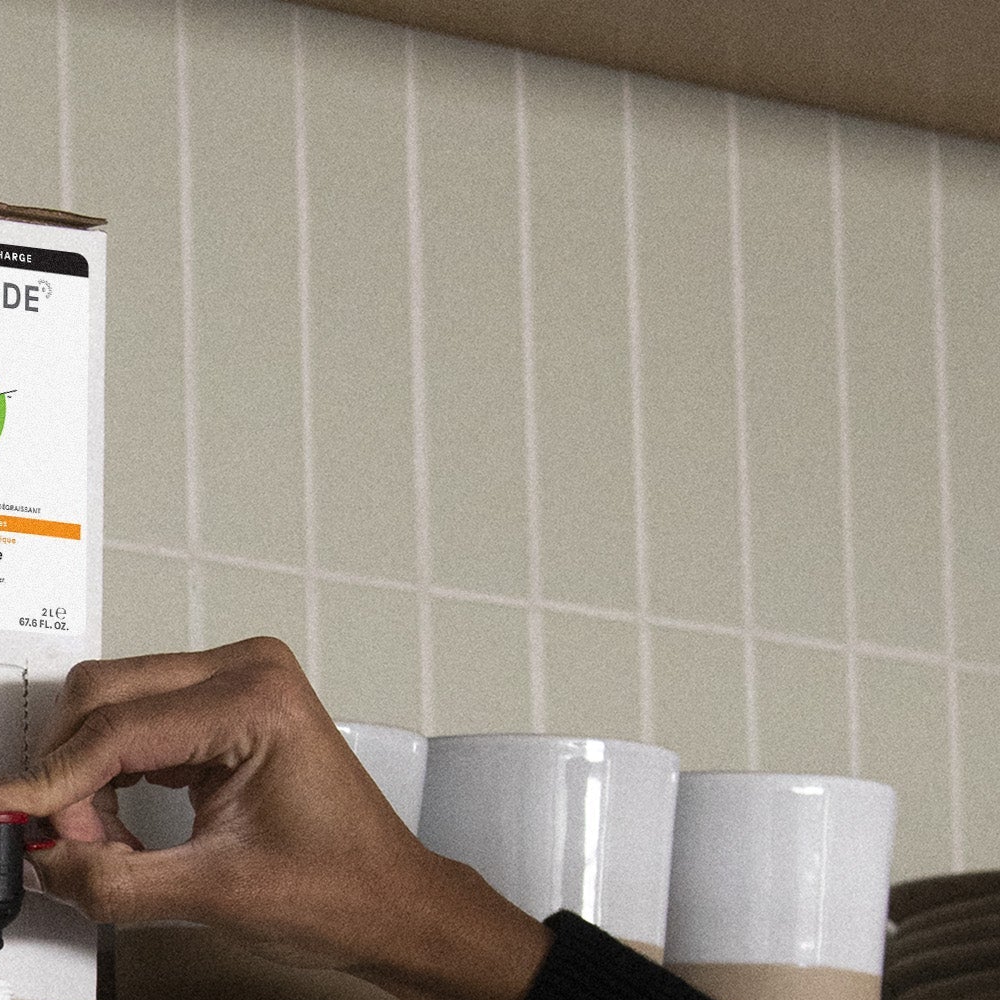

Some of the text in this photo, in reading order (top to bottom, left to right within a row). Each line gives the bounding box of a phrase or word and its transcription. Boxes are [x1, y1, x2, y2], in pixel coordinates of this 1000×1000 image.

[41, 607, 48, 617] 2
[18, 617, 69, 631] 67.6 FL. OZ.
